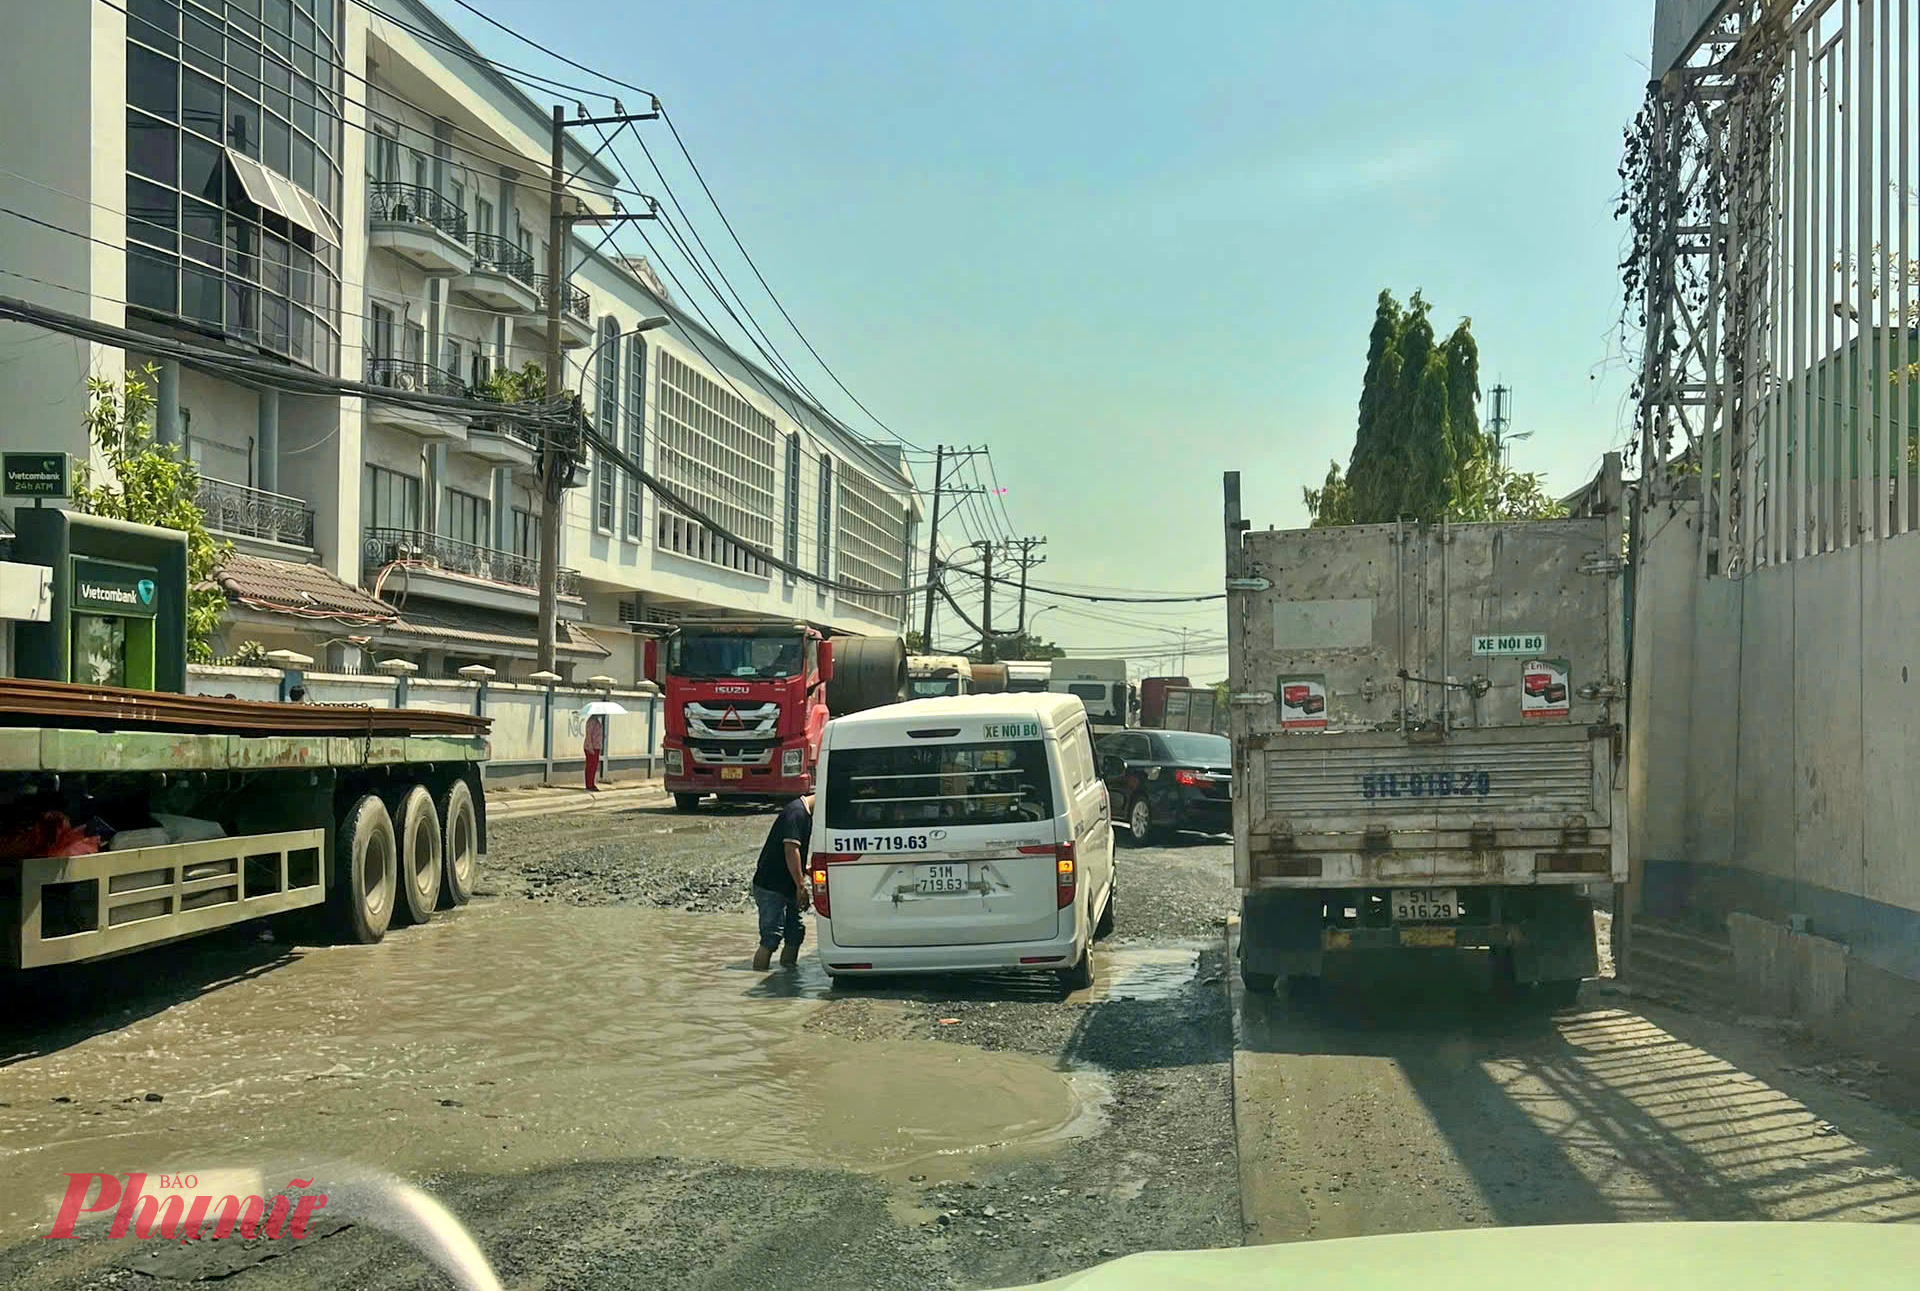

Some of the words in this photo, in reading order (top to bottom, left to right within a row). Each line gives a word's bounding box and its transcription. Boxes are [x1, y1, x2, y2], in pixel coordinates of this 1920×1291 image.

[8, 471, 61, 481] Vietcombank
[15, 482, 33, 491] 24h
[34, 482, 54, 491] ATM
[82, 583, 137, 604] Vietcombank
[1478, 638, 1494, 650] XE
[1498, 636, 1521, 651] NỘI
[1525, 636, 1542, 651] BỘ
[715, 686, 750, 694] ISUZU
[985, 725, 999, 738] XE
[834, 835, 928, 852] 51M-719.63
[929, 866, 953, 878] 51M
[921, 879, 962, 891] 719.63
[1409, 891, 1440, 903] 51L
[1398, 904, 1451, 918] 916.29
